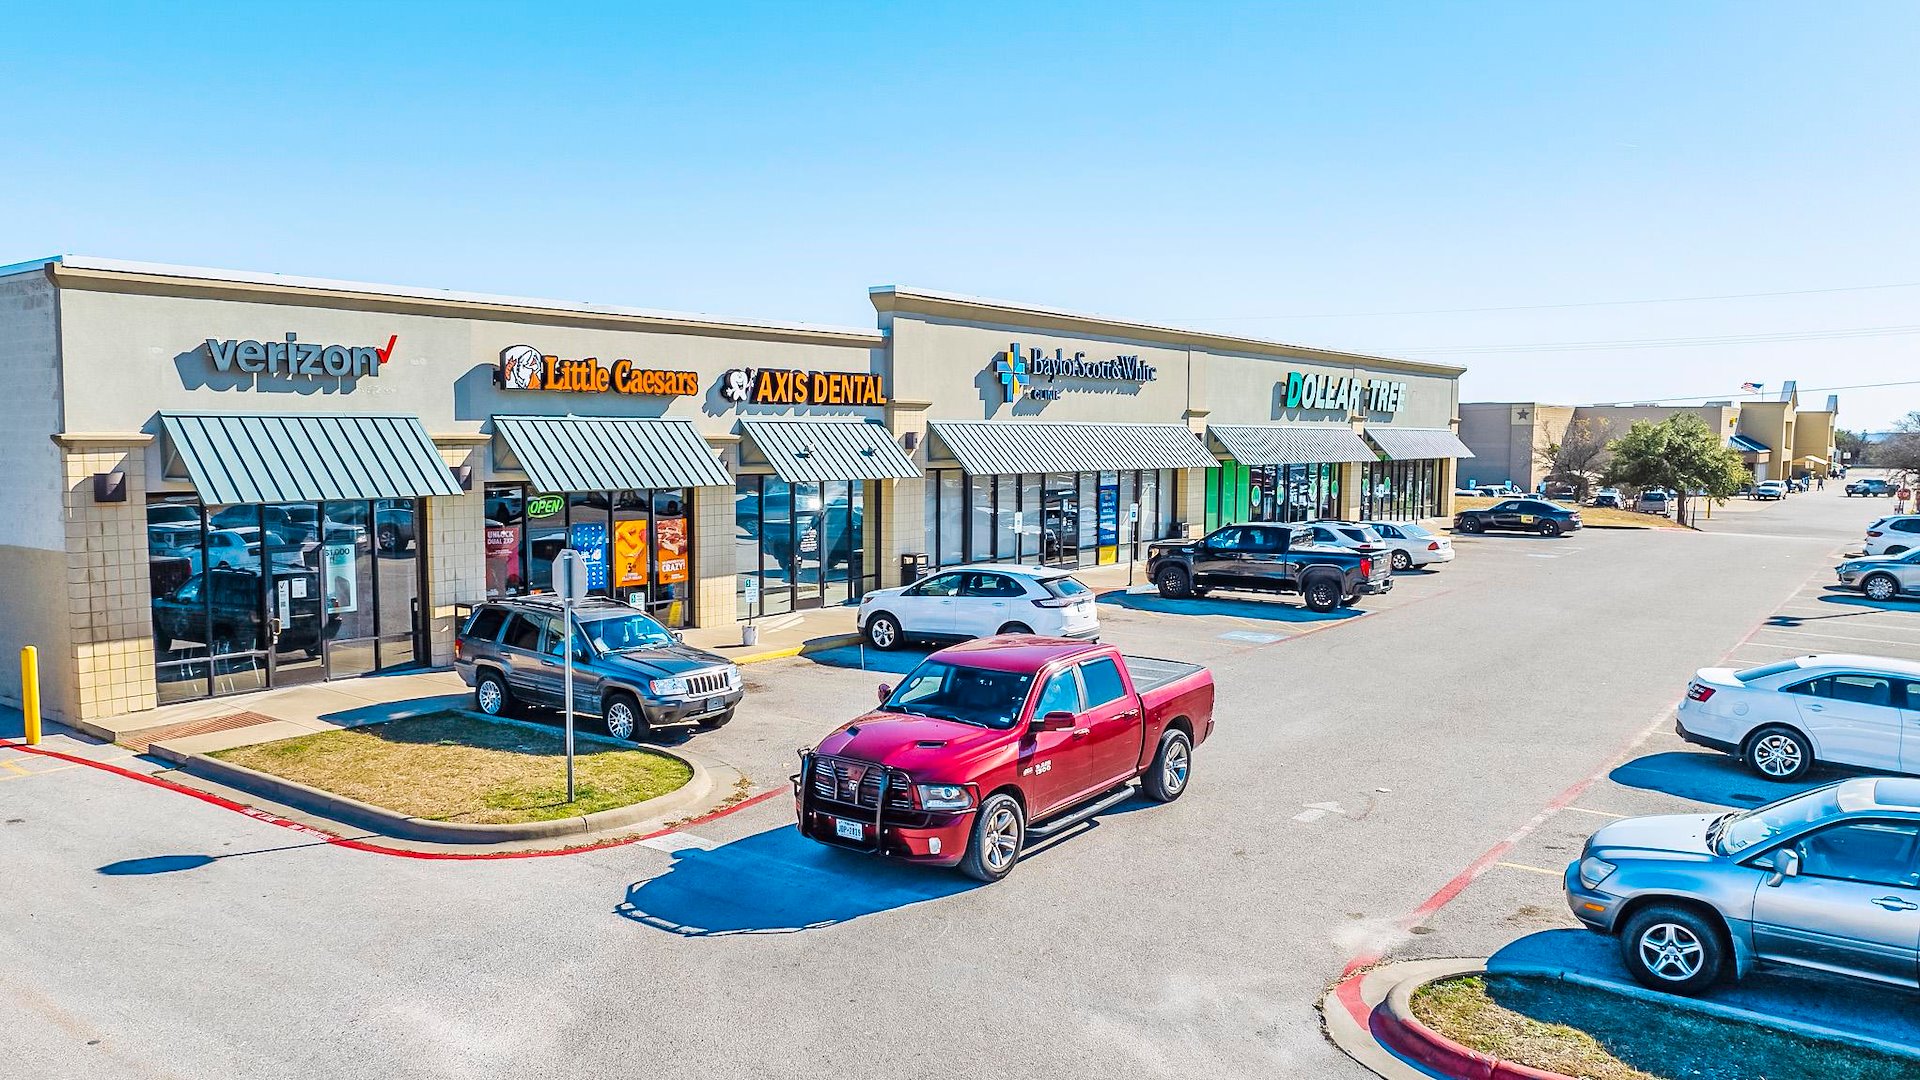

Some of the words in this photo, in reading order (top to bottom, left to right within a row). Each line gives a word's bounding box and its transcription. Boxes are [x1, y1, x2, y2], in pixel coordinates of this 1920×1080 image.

[205, 332, 380, 377] verizon
[542, 354, 609, 393] Little
[612, 359, 698, 396] Caesars
[756, 371, 808, 404] AXIS
[813, 373, 887, 405] DENTAL
[1287, 371, 1362, 411] DOLLAR
[1368, 379, 1407, 413] TREE
[530, 499, 560, 514] OPEN
[487, 530, 515, 539] UNLOCK
